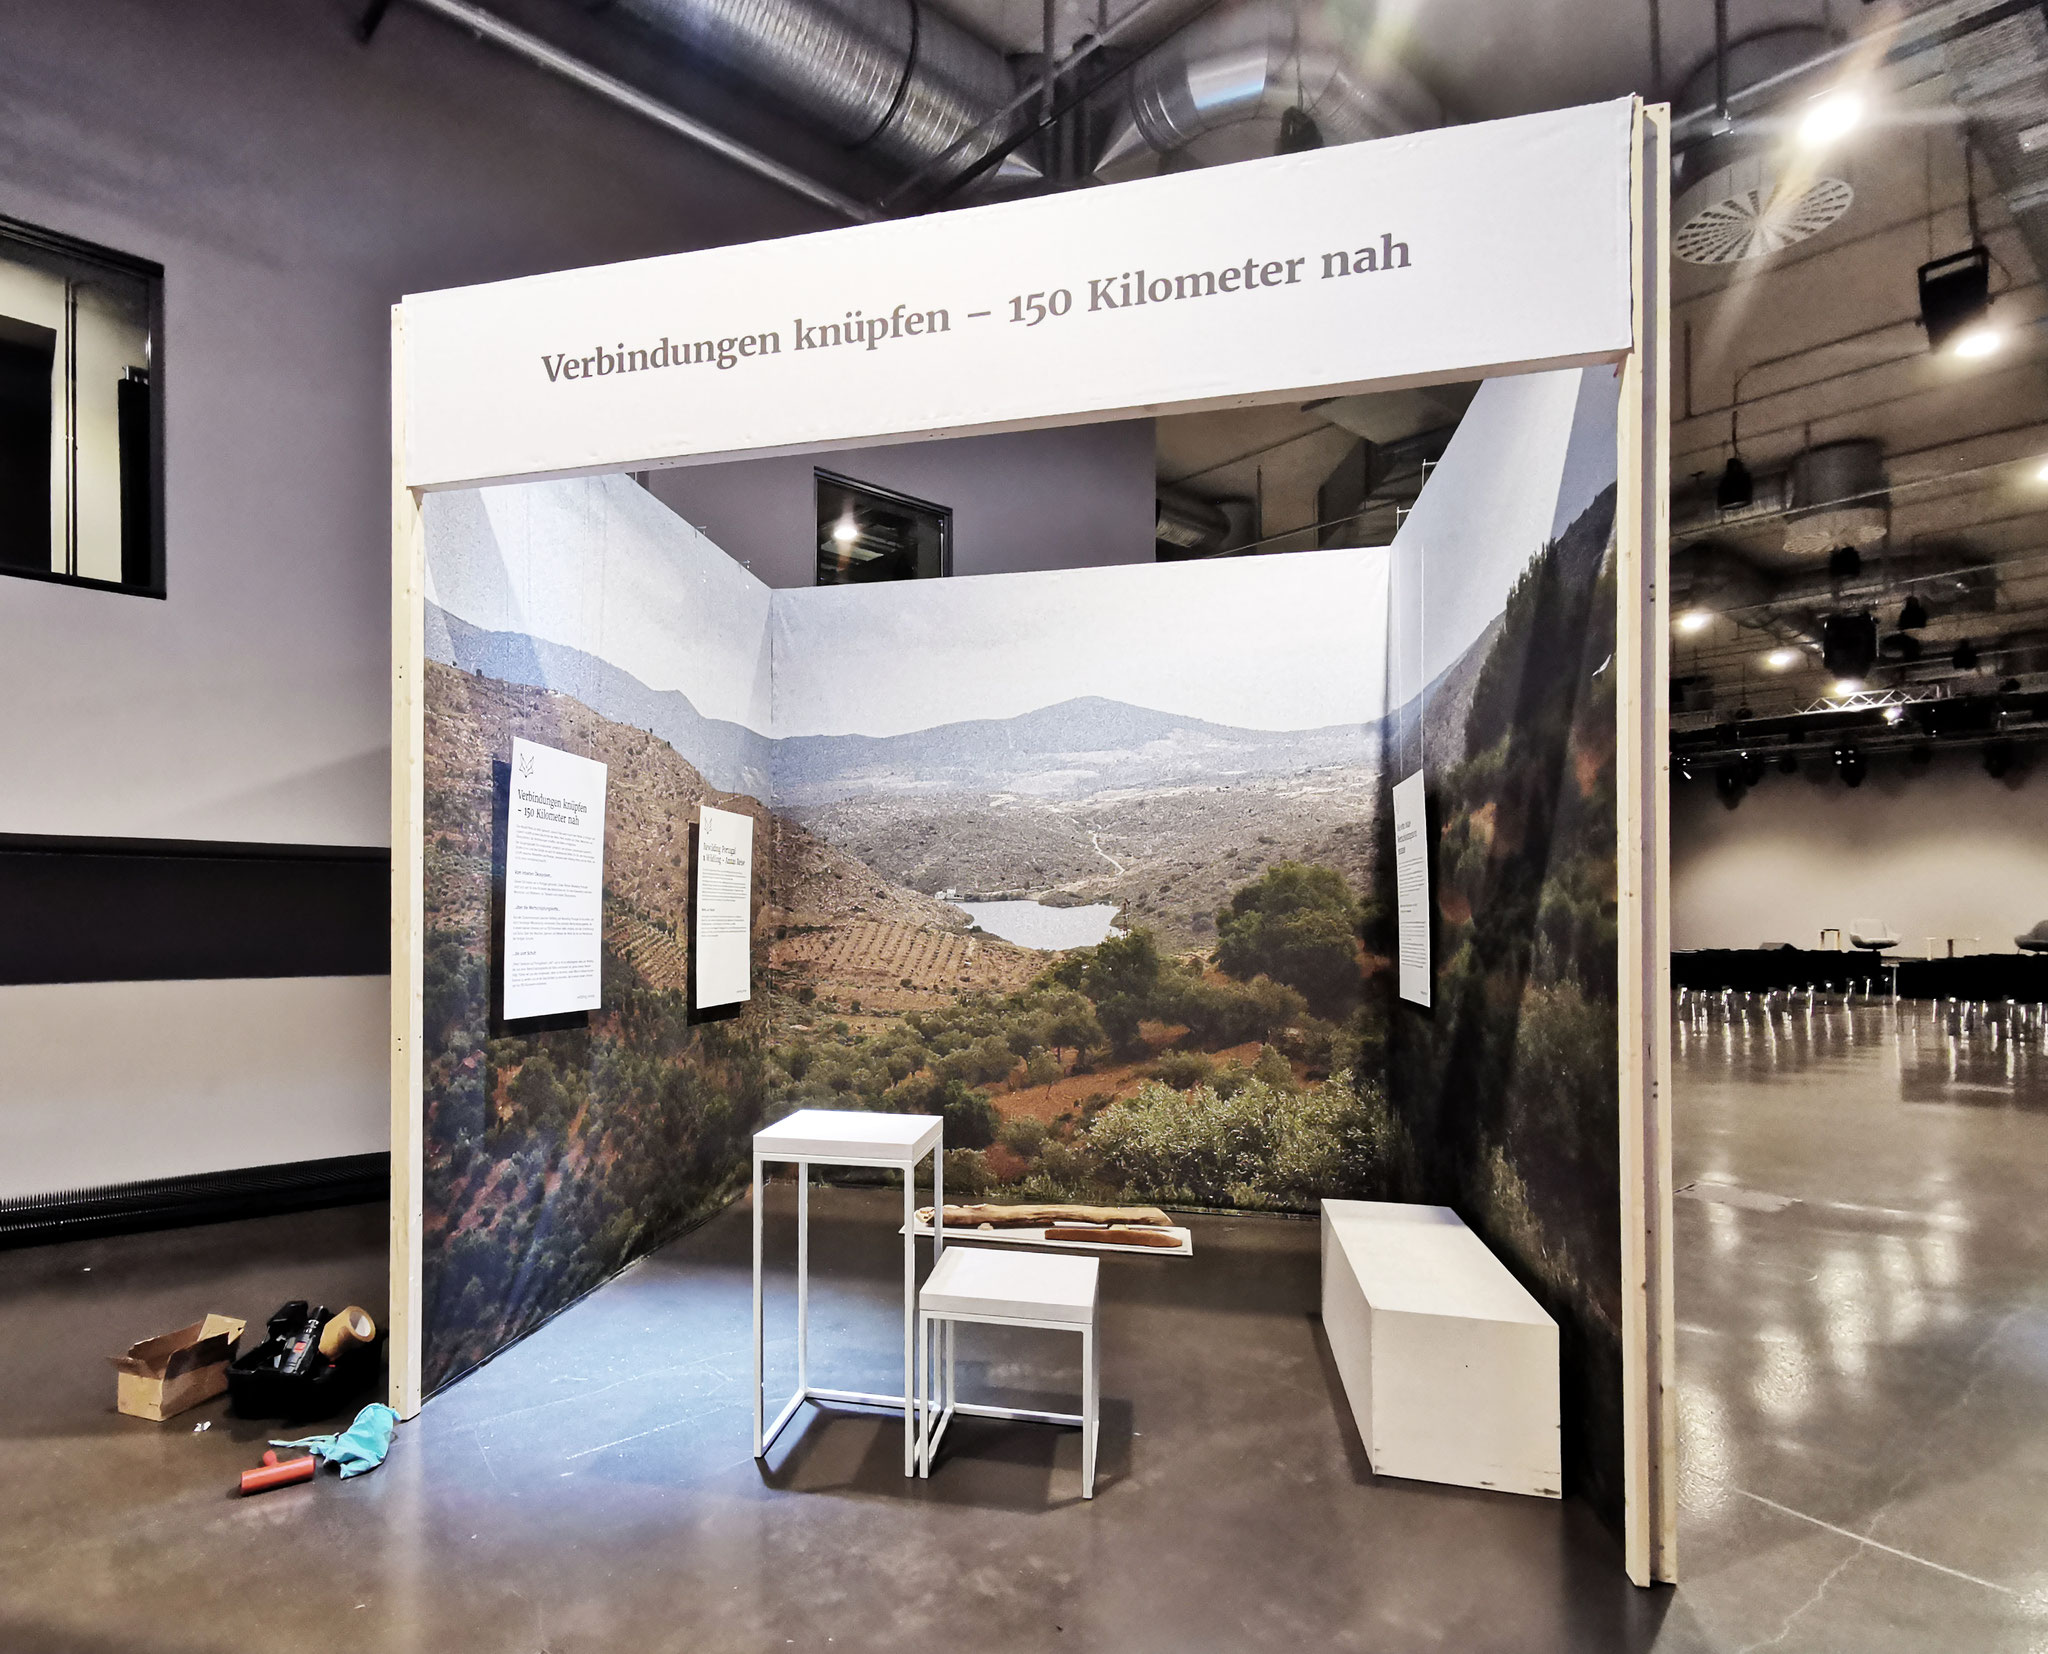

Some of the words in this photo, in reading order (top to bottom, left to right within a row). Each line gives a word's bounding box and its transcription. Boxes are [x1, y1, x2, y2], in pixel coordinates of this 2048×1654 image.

[541, 331, 781, 382] Verbindungen
[794, 304, 951, 351] knüpfen
[1008, 289, 1073, 327] 150
[1088, 257, 1305, 312] Kilometer
[1320, 232, 1412, 279] nah
[517, 788, 562, 810] Verbindungen
[563, 798, 588, 814] knüpfen
[524, 807, 535, 818] 150
[536, 808, 567, 823] Kilometer
[567, 815, 580, 825] nah
